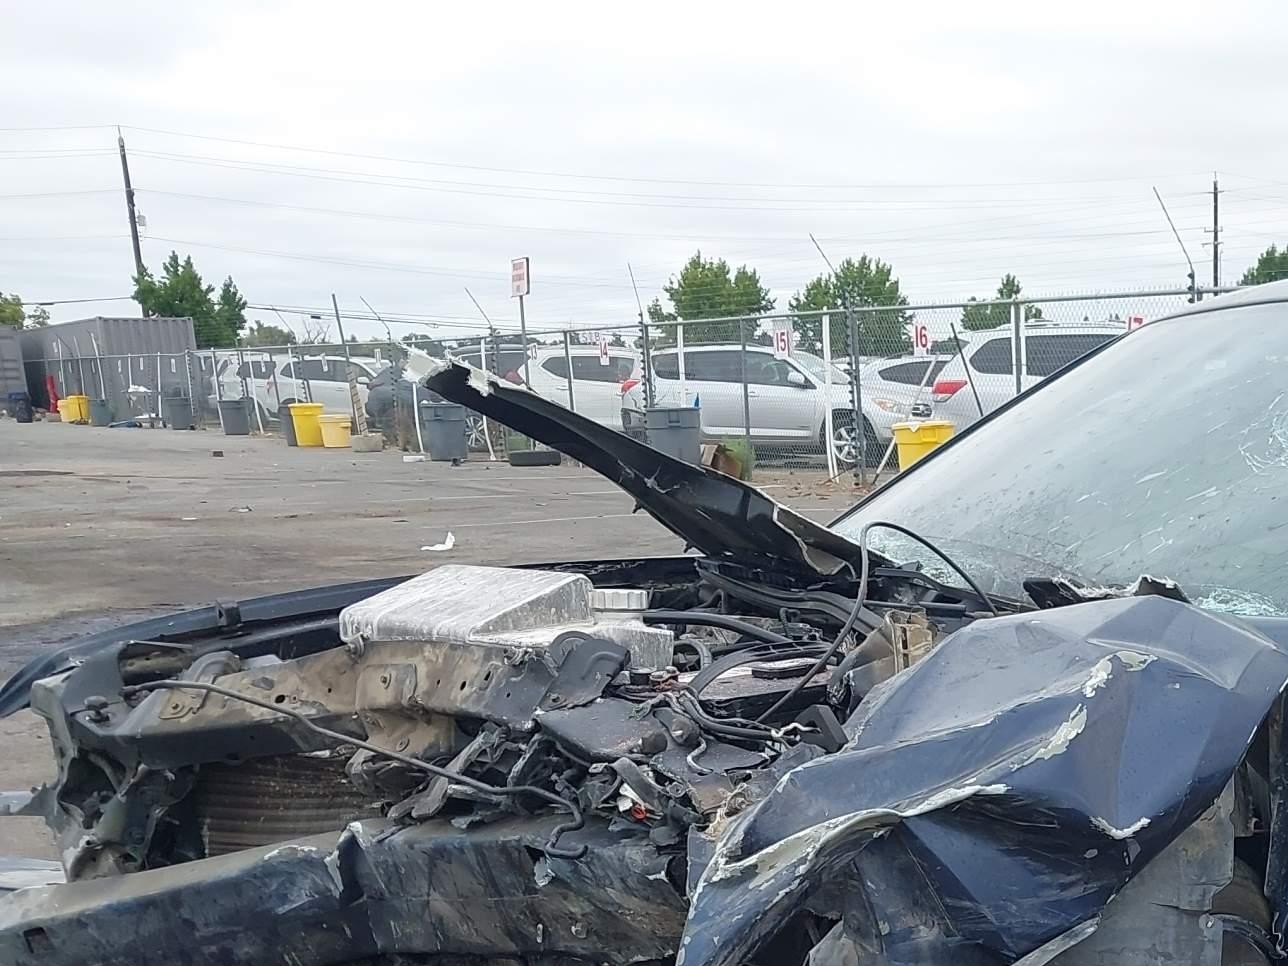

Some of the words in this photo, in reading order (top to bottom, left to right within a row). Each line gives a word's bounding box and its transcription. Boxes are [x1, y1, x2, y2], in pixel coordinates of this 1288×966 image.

[775, 331, 787, 352] 15
[914, 325, 928, 349] 16
[599, 341, 608, 359] 14
